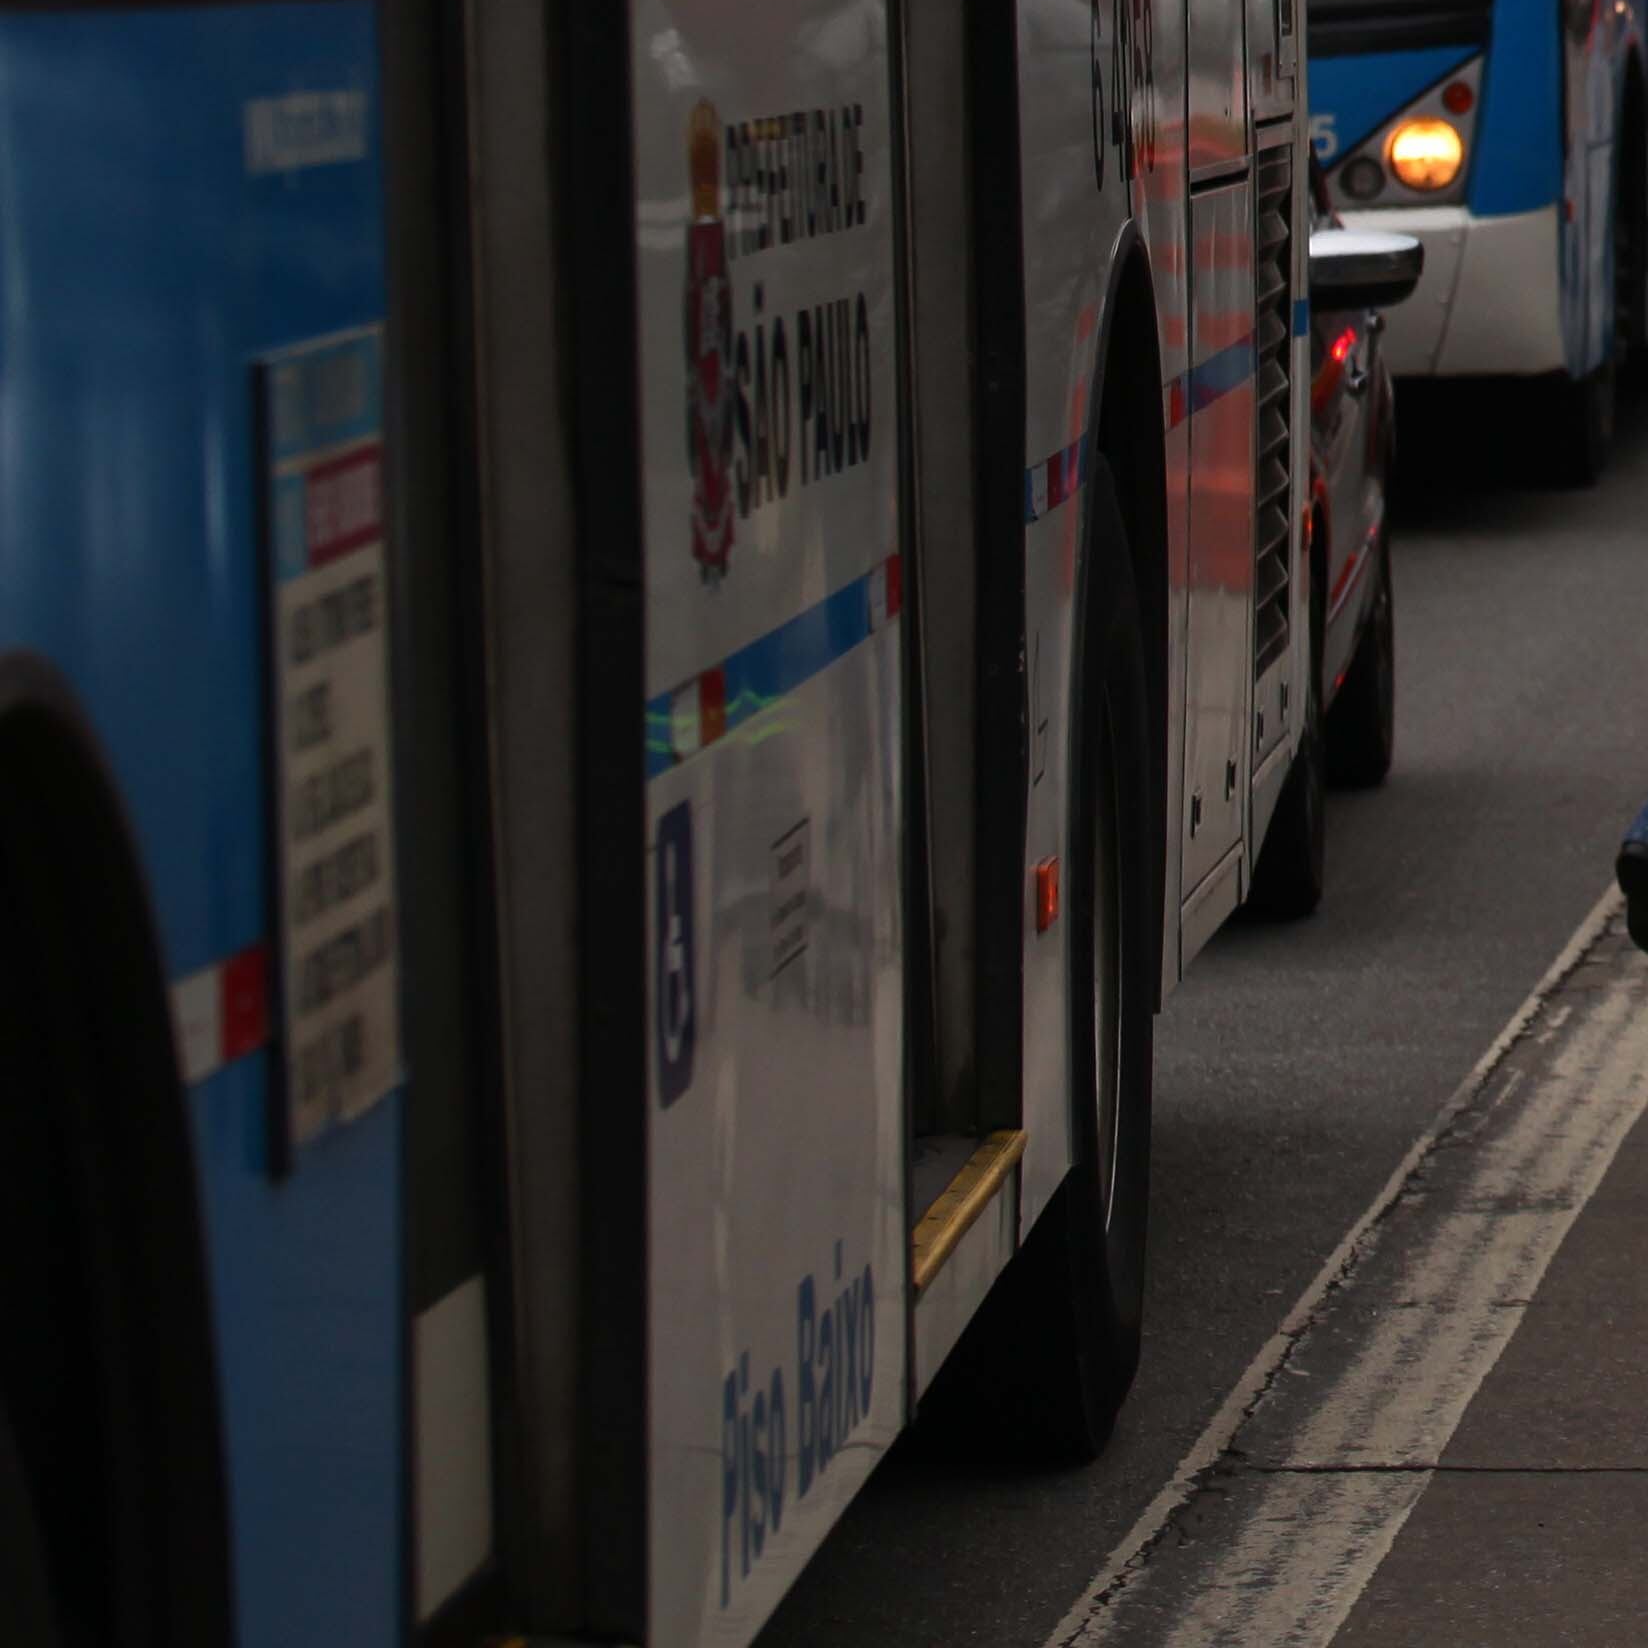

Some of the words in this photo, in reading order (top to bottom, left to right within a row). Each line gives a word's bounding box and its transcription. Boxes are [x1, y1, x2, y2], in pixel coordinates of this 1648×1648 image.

[736, 281, 791, 520] SÃO
[798, 292, 870, 487] PAULO
[720, 1350, 785, 1610] Piso
[797, 1238, 874, 1500] Baixo
